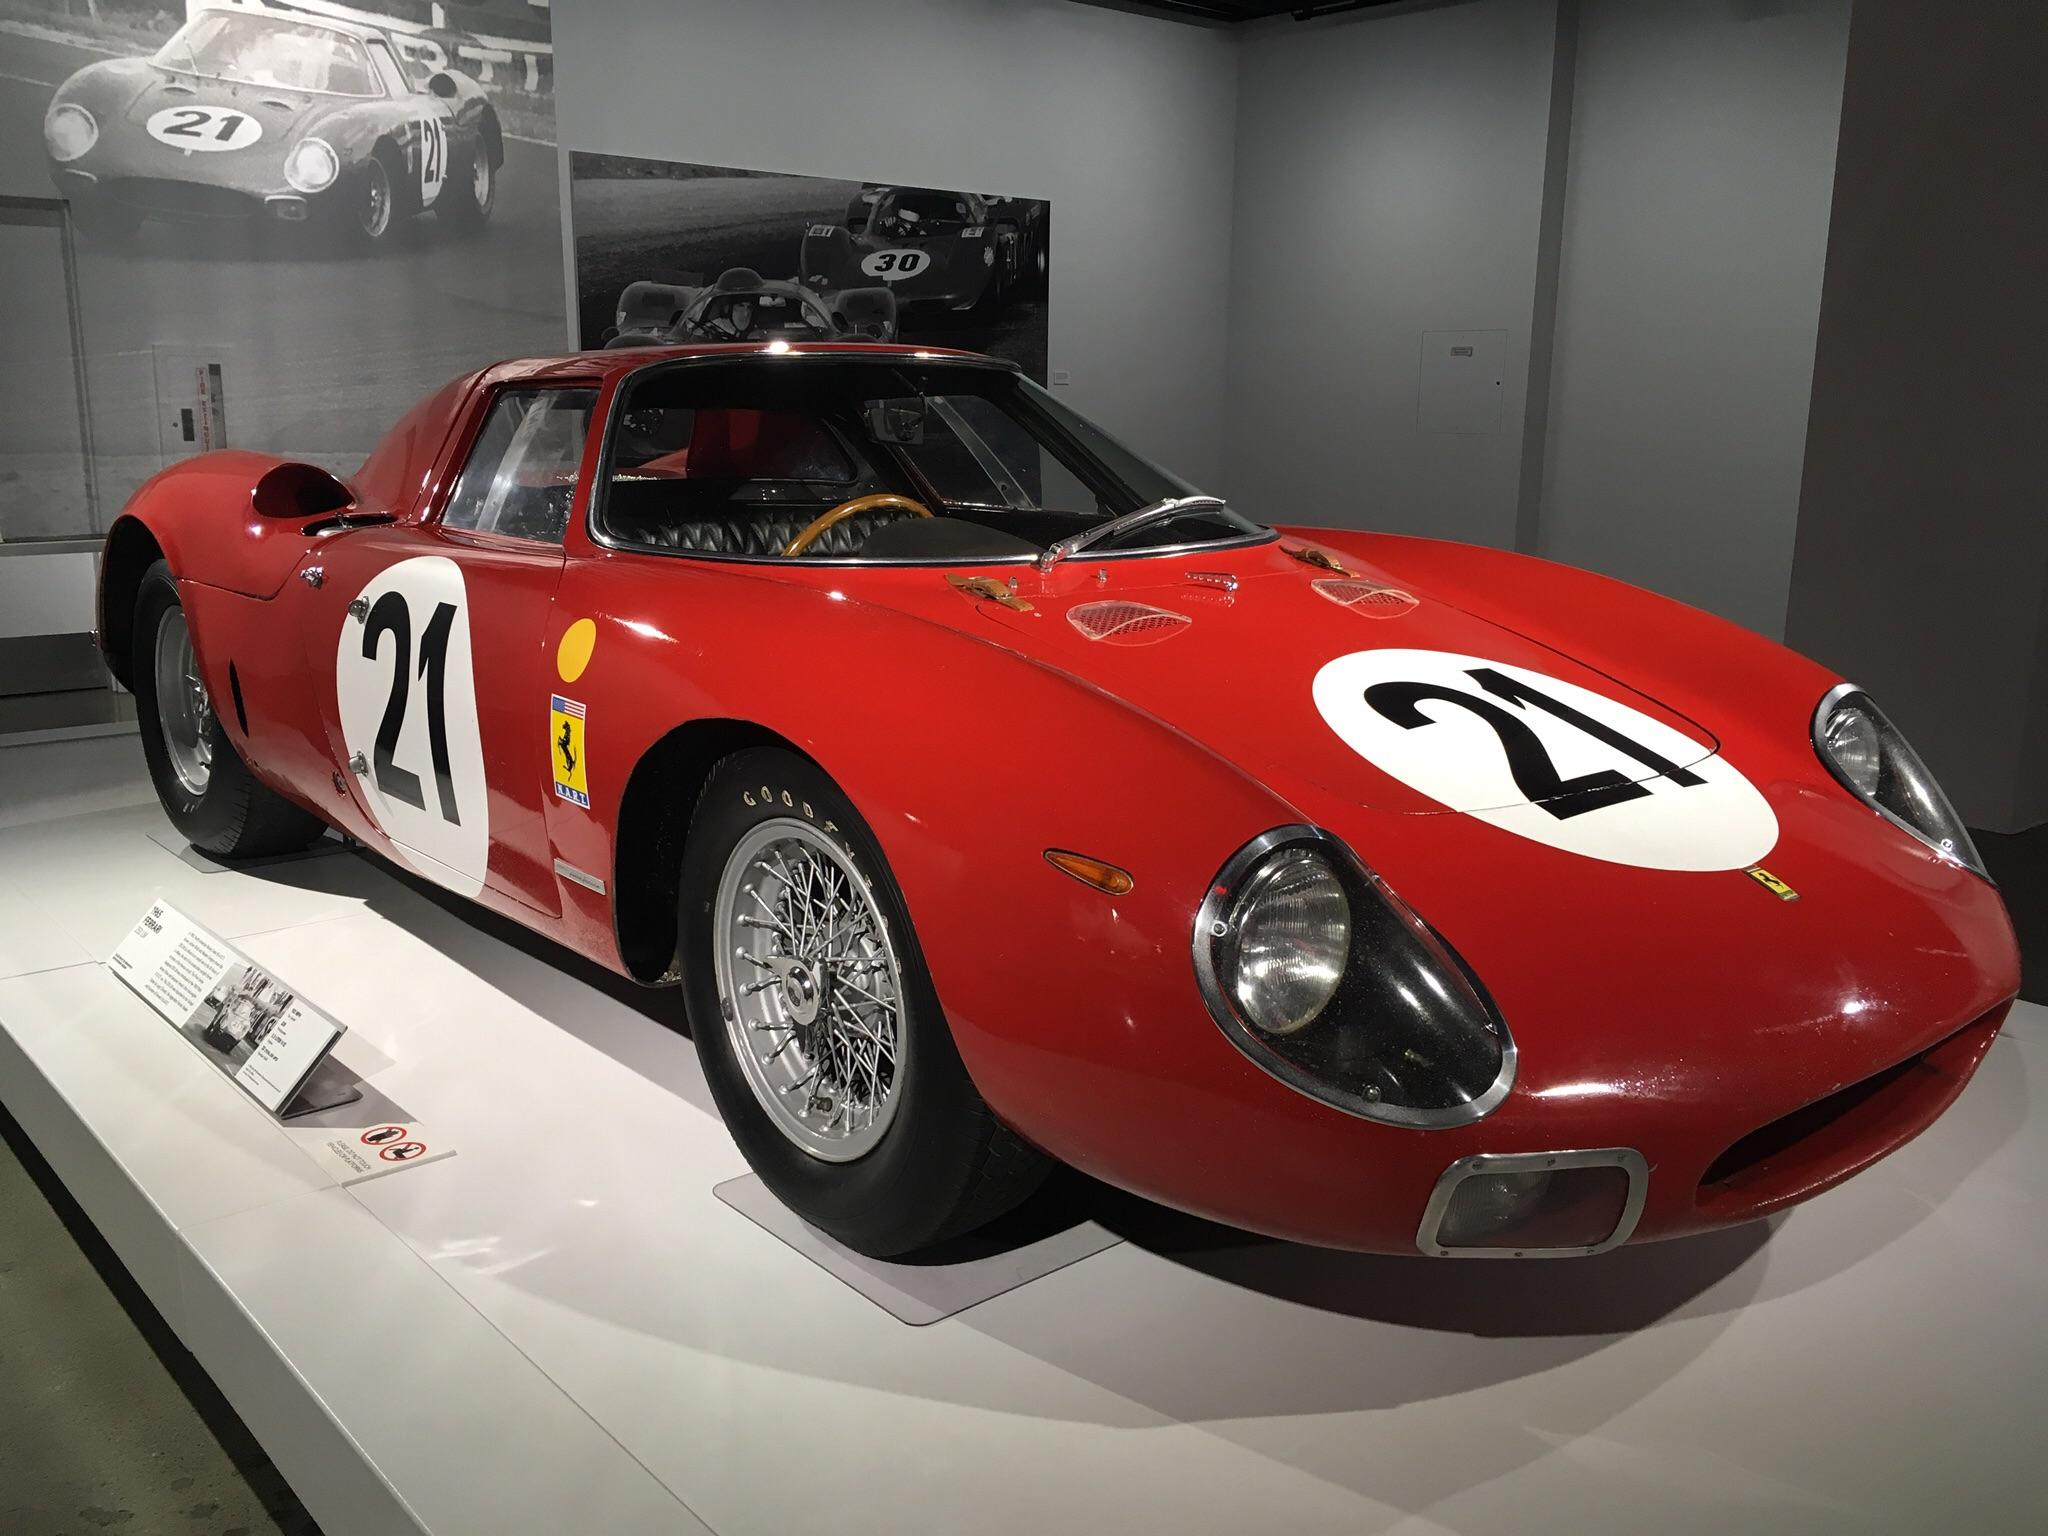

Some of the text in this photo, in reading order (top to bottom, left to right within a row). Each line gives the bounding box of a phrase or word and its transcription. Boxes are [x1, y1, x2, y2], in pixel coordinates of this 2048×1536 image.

[163, 110, 244, 142] 21
[424, 117, 443, 183] 21
[874, 254, 921, 272] 30
[362, 591, 461, 826] 21
[1363, 668, 1708, 820] 21
[142, 915, 163, 934] FERRARI
